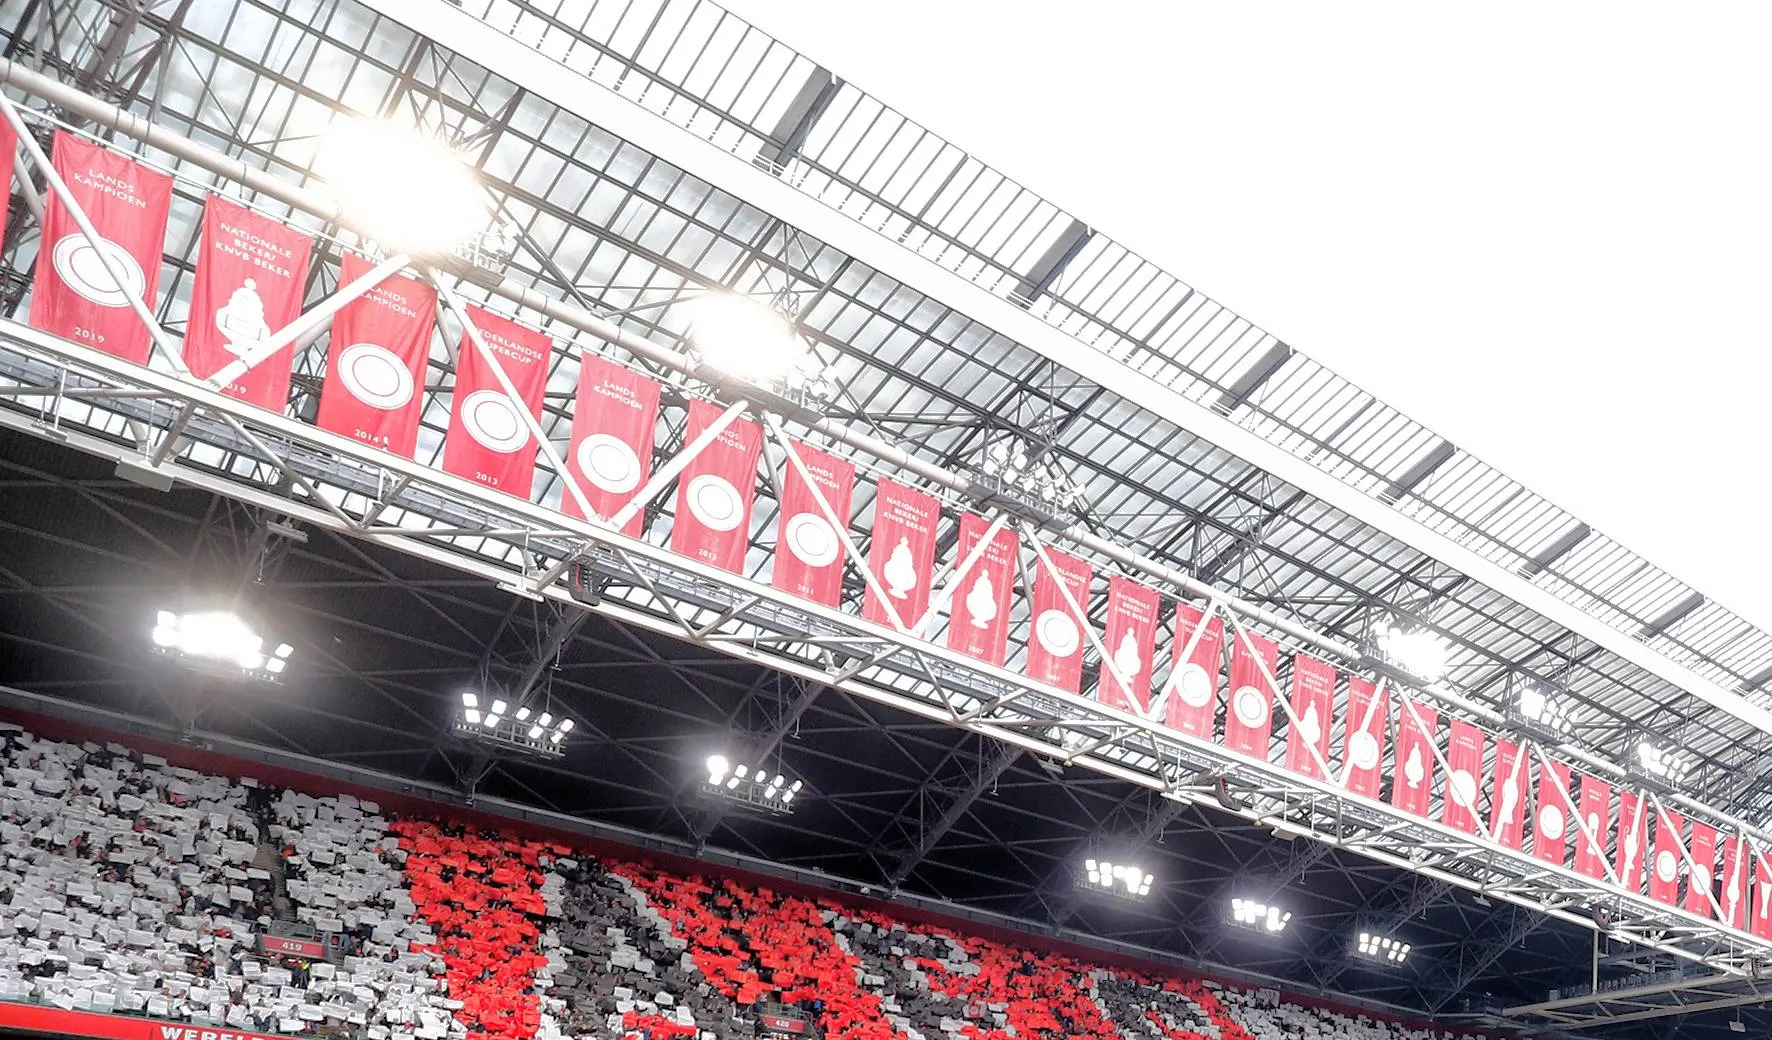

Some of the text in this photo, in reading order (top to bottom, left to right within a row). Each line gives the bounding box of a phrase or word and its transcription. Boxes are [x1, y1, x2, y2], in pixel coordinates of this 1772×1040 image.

[73, 173, 147, 209] KAMPIOEN
[88, 168, 136, 193] LANDS
[220, 223, 292, 259] NATIONALE
[234, 238, 277, 261] BEKER/
[215, 241, 293, 279] KNVB BEKER
[74, 327, 105, 344] 2019
[594, 385, 643, 410] KAMPIOEN
[604, 380, 636, 399] LANDS
[354, 429, 380, 444] 2014
[475, 472, 499, 485] 2013
